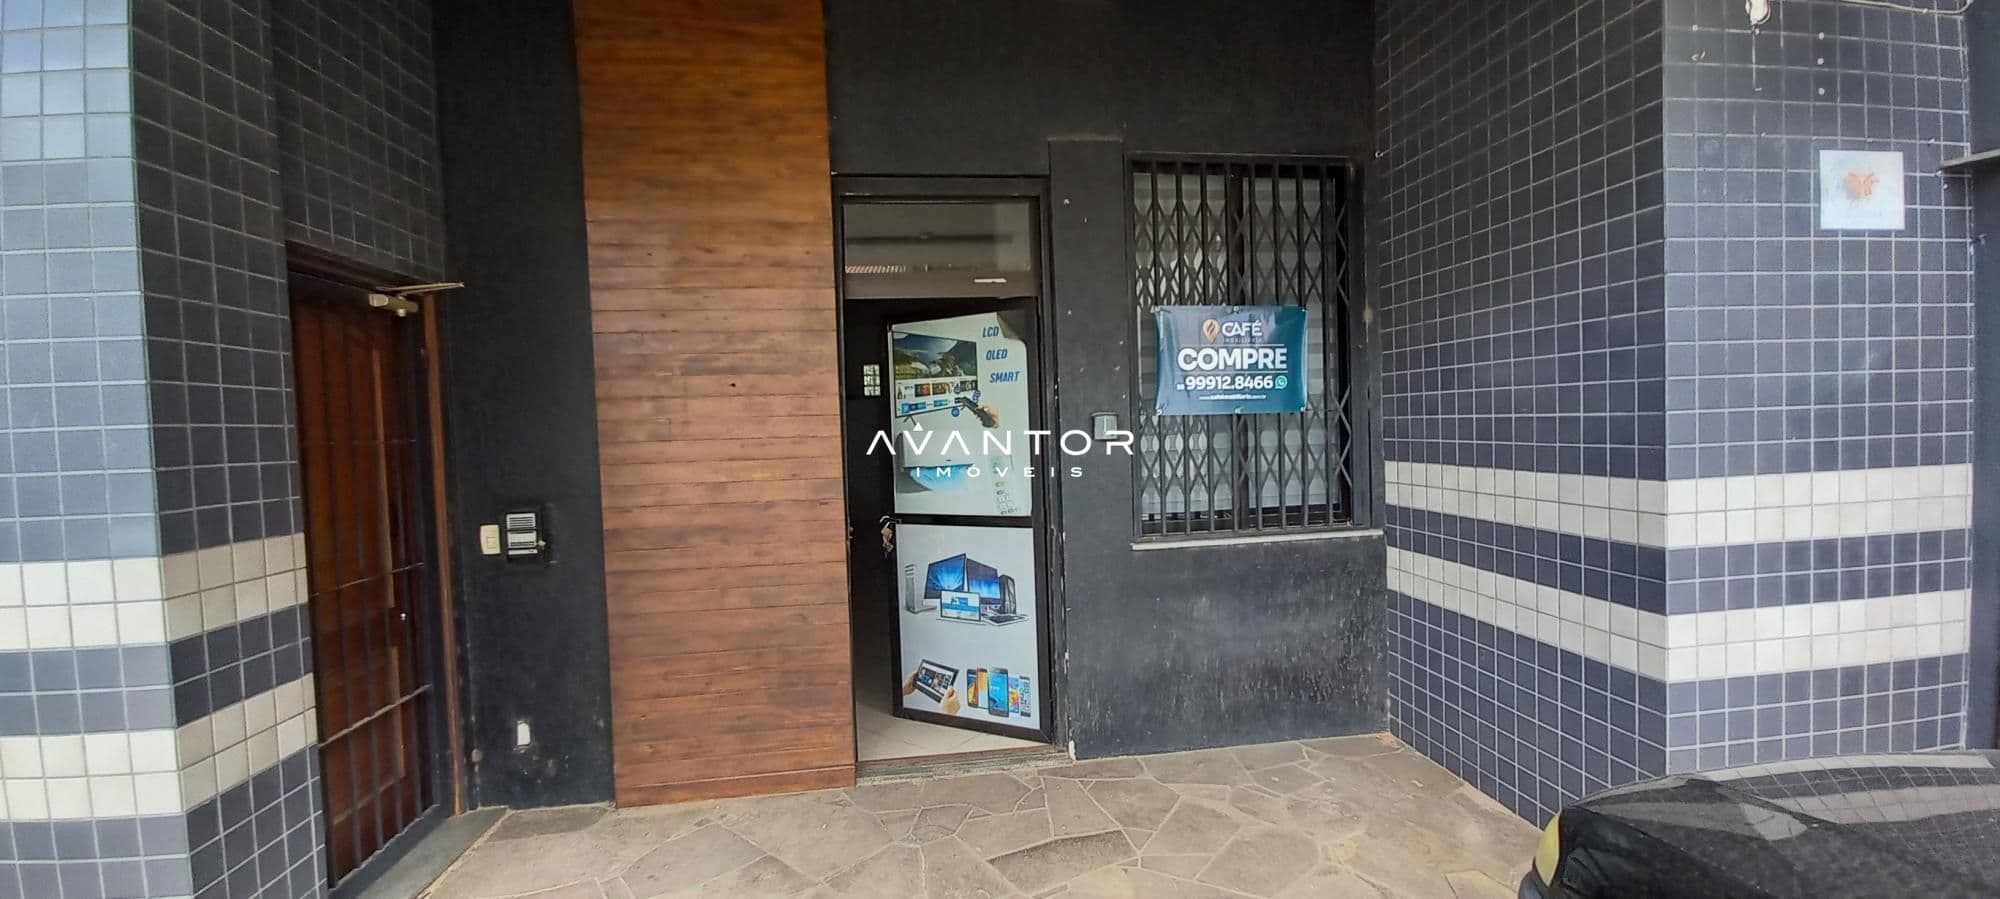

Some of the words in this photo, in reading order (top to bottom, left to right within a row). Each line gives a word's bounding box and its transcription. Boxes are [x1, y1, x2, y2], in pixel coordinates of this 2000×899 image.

[983, 326, 999, 338] LCD
[1222, 320, 1262, 337] CAFÉ
[1177, 347, 1288, 371] COMPRE
[990, 371, 1020, 383] SMART
[1185, 375, 1274, 390] 99912.8466
